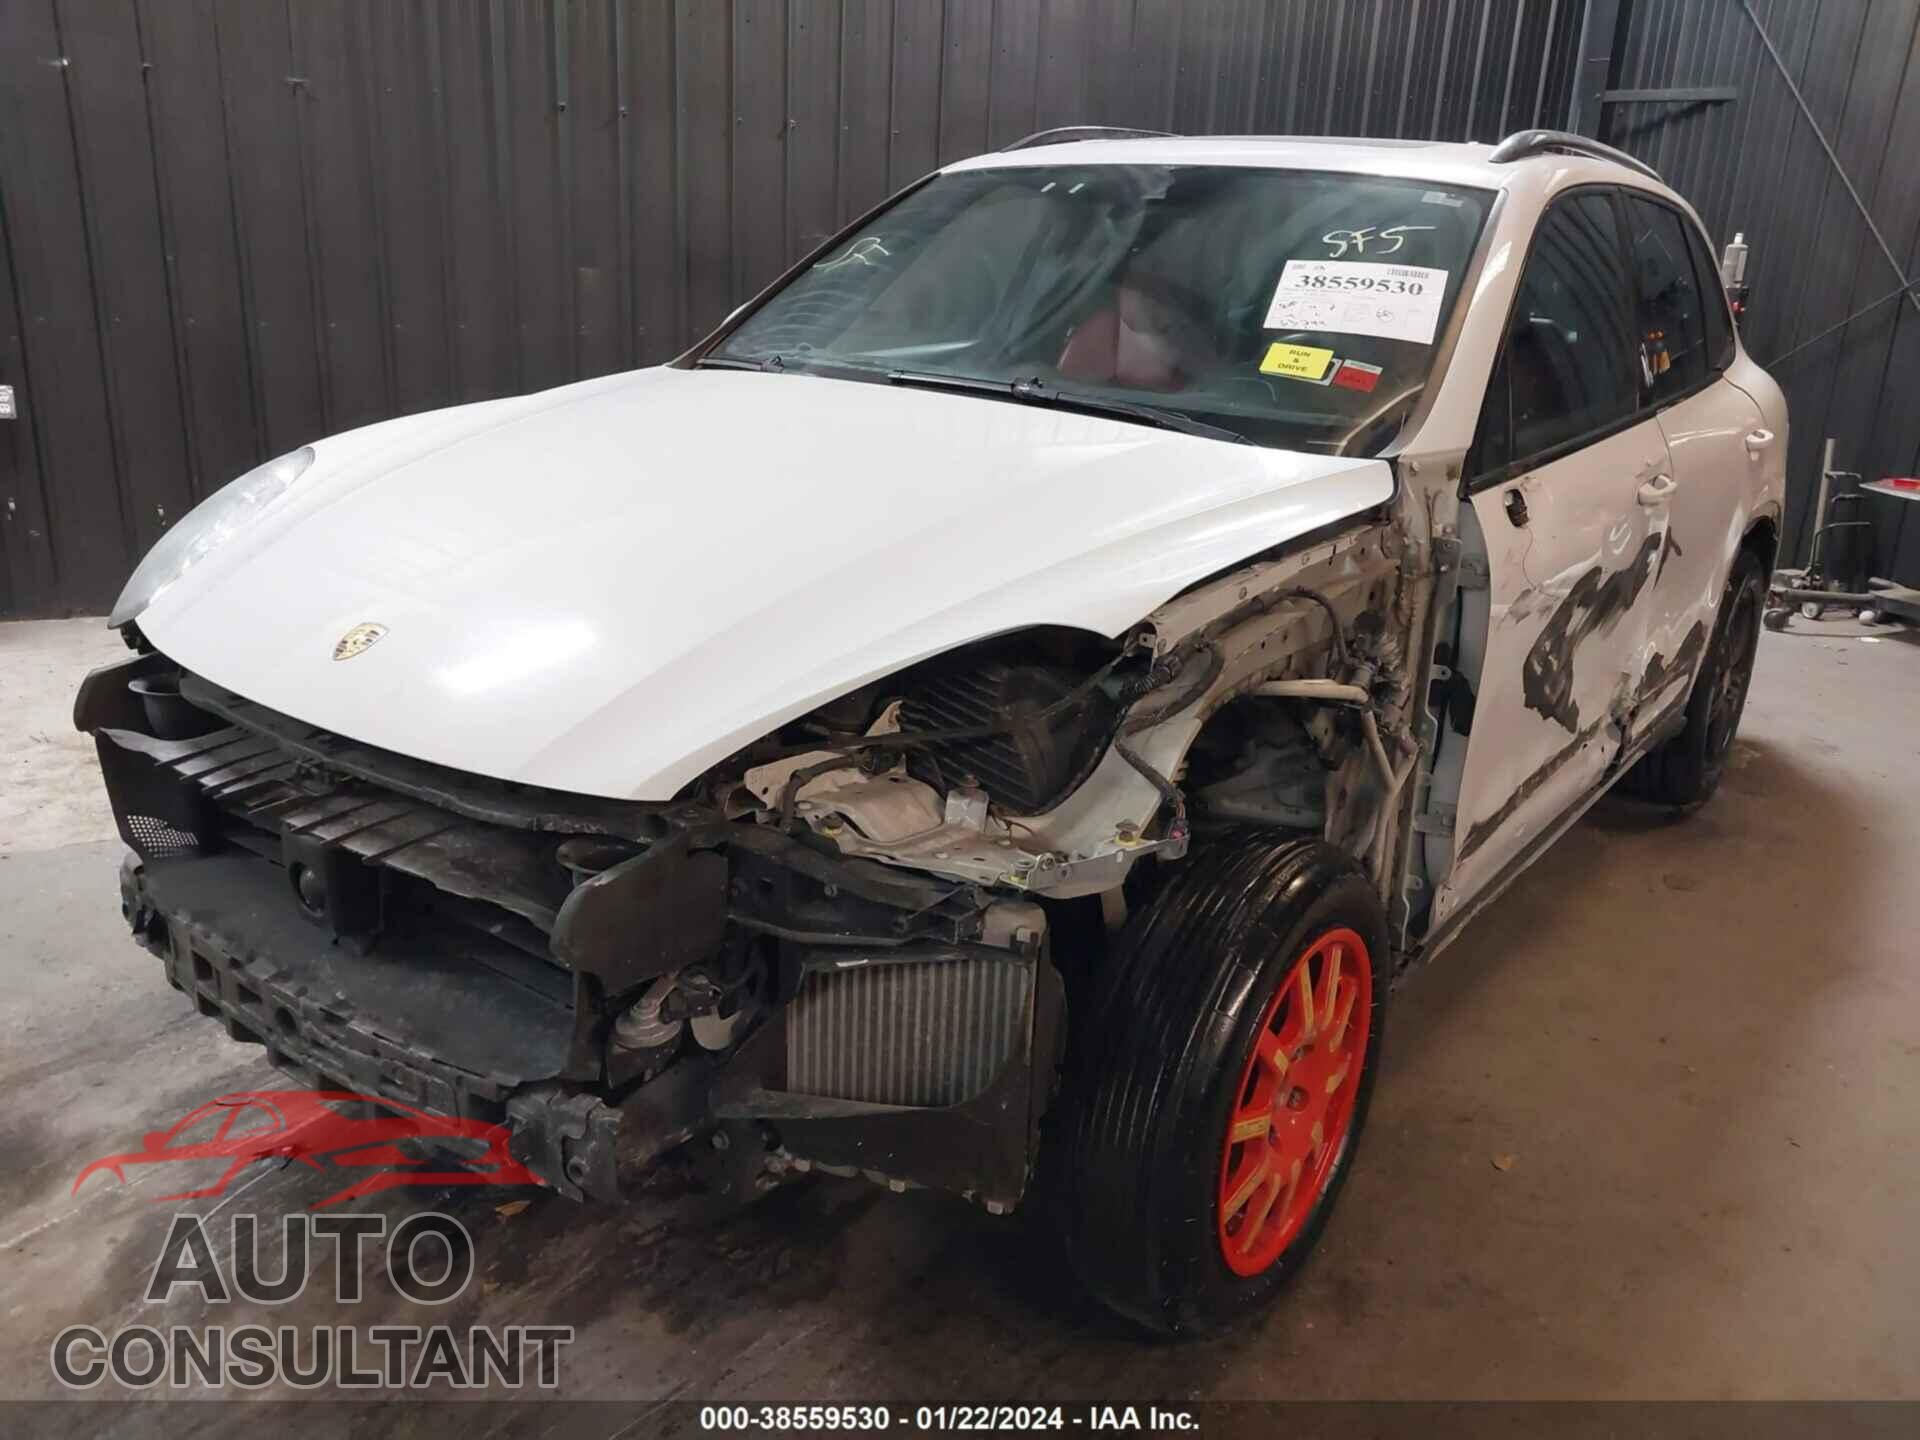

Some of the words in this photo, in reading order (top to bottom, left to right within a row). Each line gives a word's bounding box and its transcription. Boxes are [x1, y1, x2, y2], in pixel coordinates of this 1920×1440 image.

[1294, 274, 1424, 297] 38559530
[1289, 349, 1311, 357] RUN
[1277, 362, 1309, 372] DRIVE
